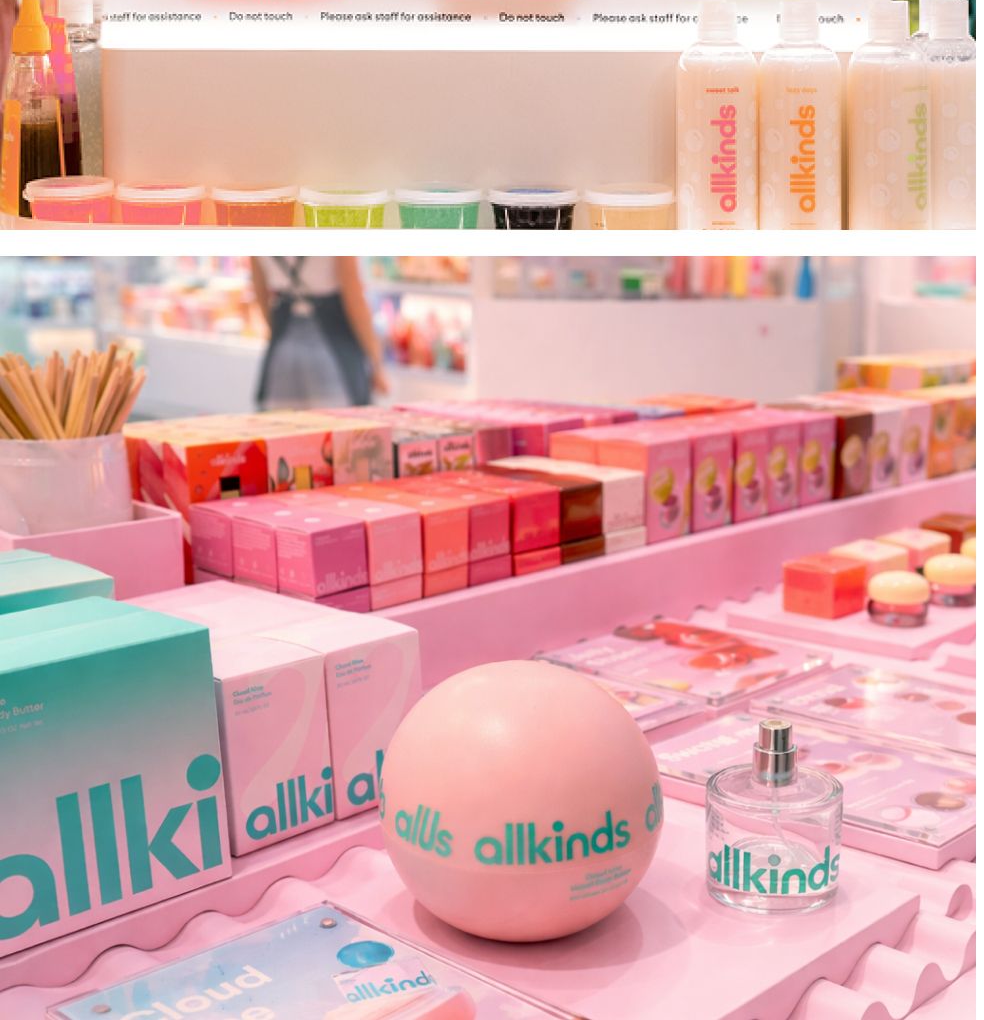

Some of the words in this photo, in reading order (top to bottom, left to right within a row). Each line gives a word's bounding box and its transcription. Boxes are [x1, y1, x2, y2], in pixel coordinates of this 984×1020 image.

[132, 12, 146, 22] for
[148, 12, 202, 22] assistance
[229, 12, 243, 21] Do
[245, 12, 262, 21] not
[264, 11, 293, 21] touch
[320, 11, 353, 22] Please
[355, 11, 372, 21] ask
[375, 11, 399, 21] staff
[400, 11, 415, 22] for
[417, 11, 472, 22] assistance
[499, 12, 514, 22] Do
[516, 12, 533, 22] not
[535, 12, 565, 22] touch
[592, 13, 627, 23] Please
[628, 13, 647, 23] ask
[649, 13, 674, 23] staff
[675, 13, 691, 23] for
[710, 104, 737, 212] allkinds
[790, 104, 816, 213] allkinds
[907, 102, 928, 211] allkinds
[13, 702, 44, 716] Butter
[246, 766, 333, 841] allki
[0, 754, 224, 941] allki
[474, 809, 632, 866] allkinds
[709, 844, 840, 895] allkinds
